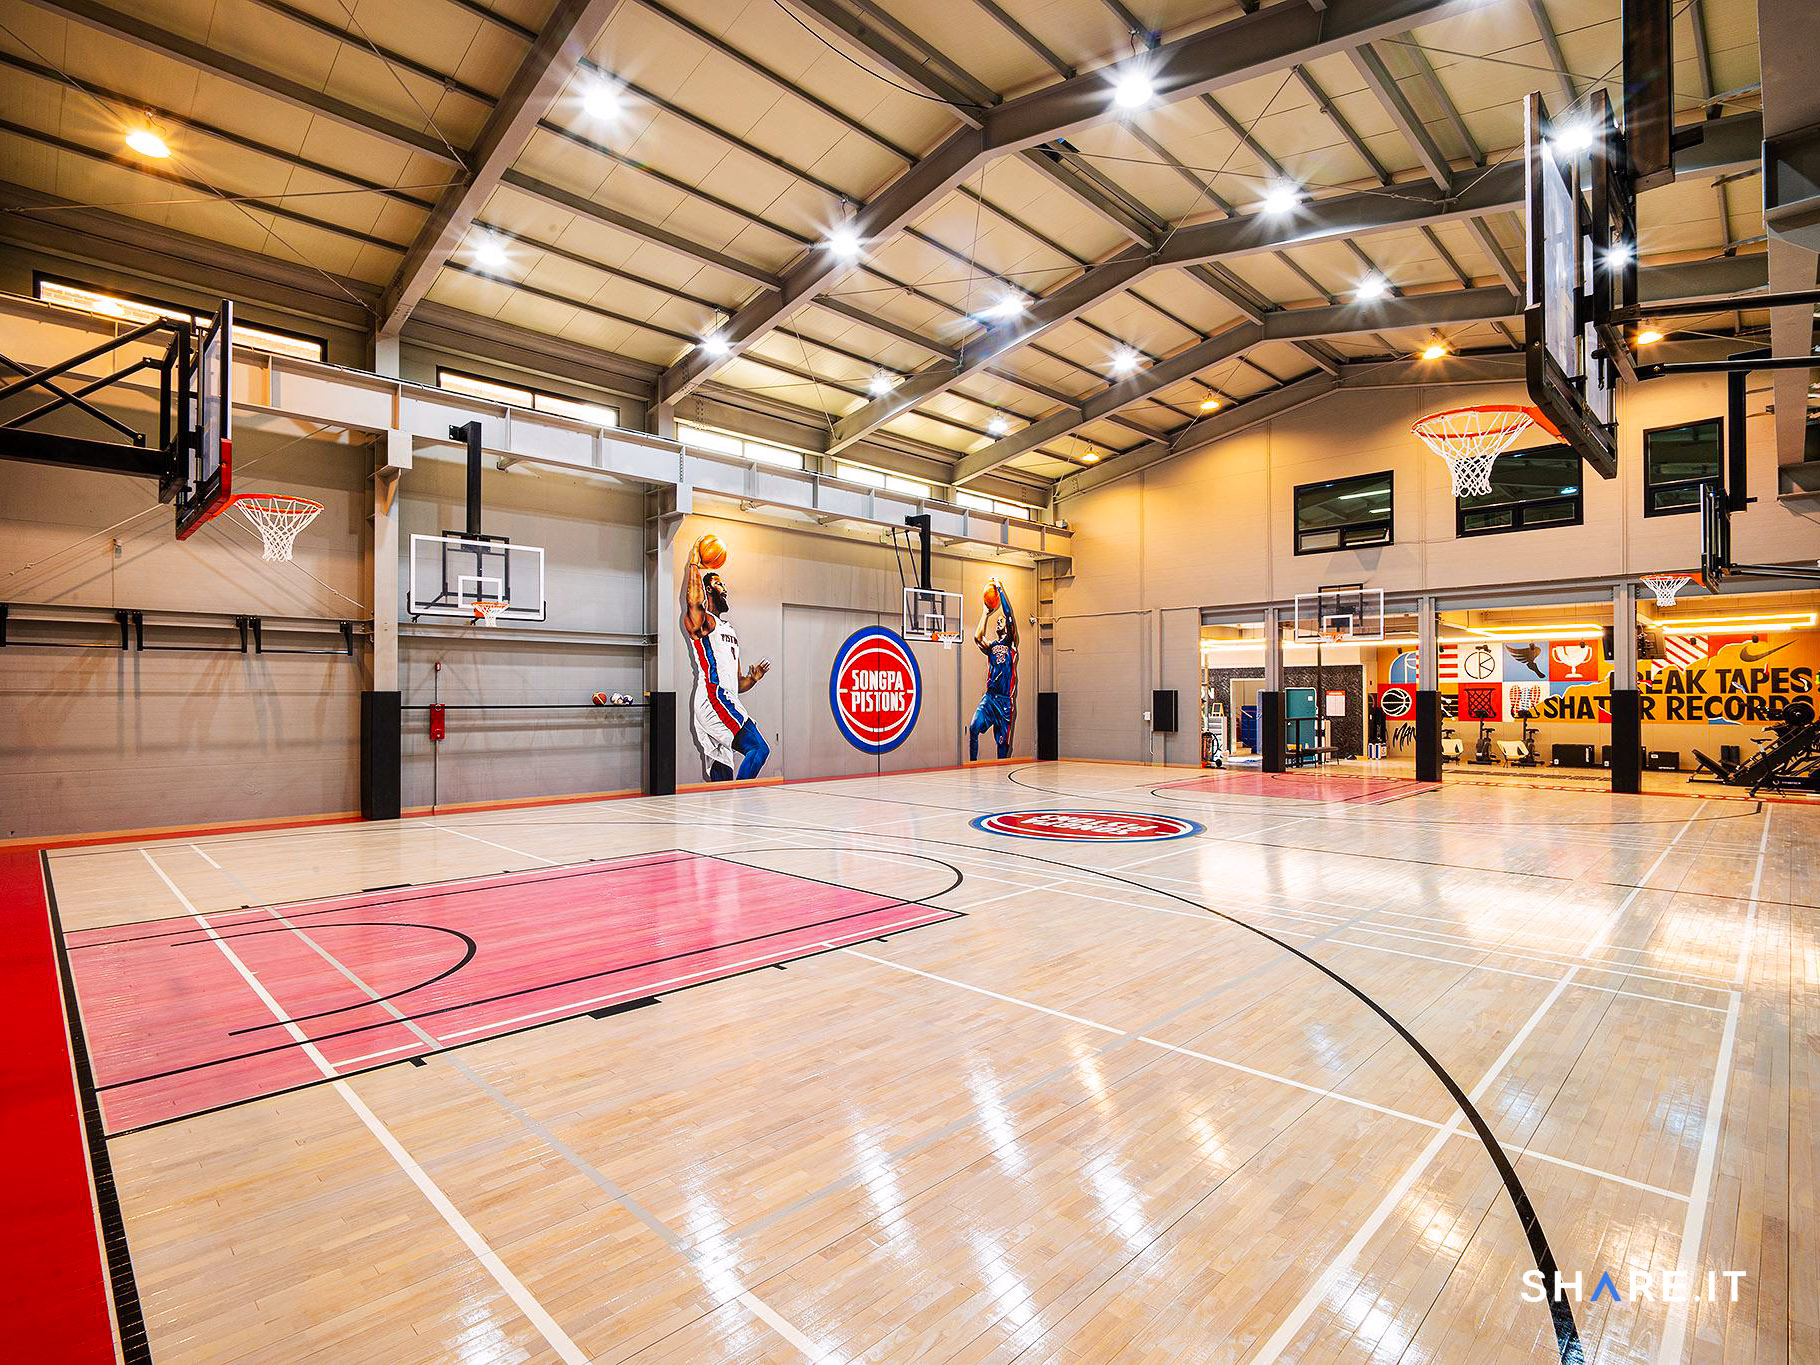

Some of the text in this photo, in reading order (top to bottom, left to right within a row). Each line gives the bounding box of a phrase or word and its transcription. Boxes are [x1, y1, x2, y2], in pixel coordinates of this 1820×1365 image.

[851, 669, 905, 691] SONGPA
[1609, 667, 1813, 695] EAK TAPES
[849, 691, 906, 713] PISTONS
[1543, 695, 1656, 720] SHATR
